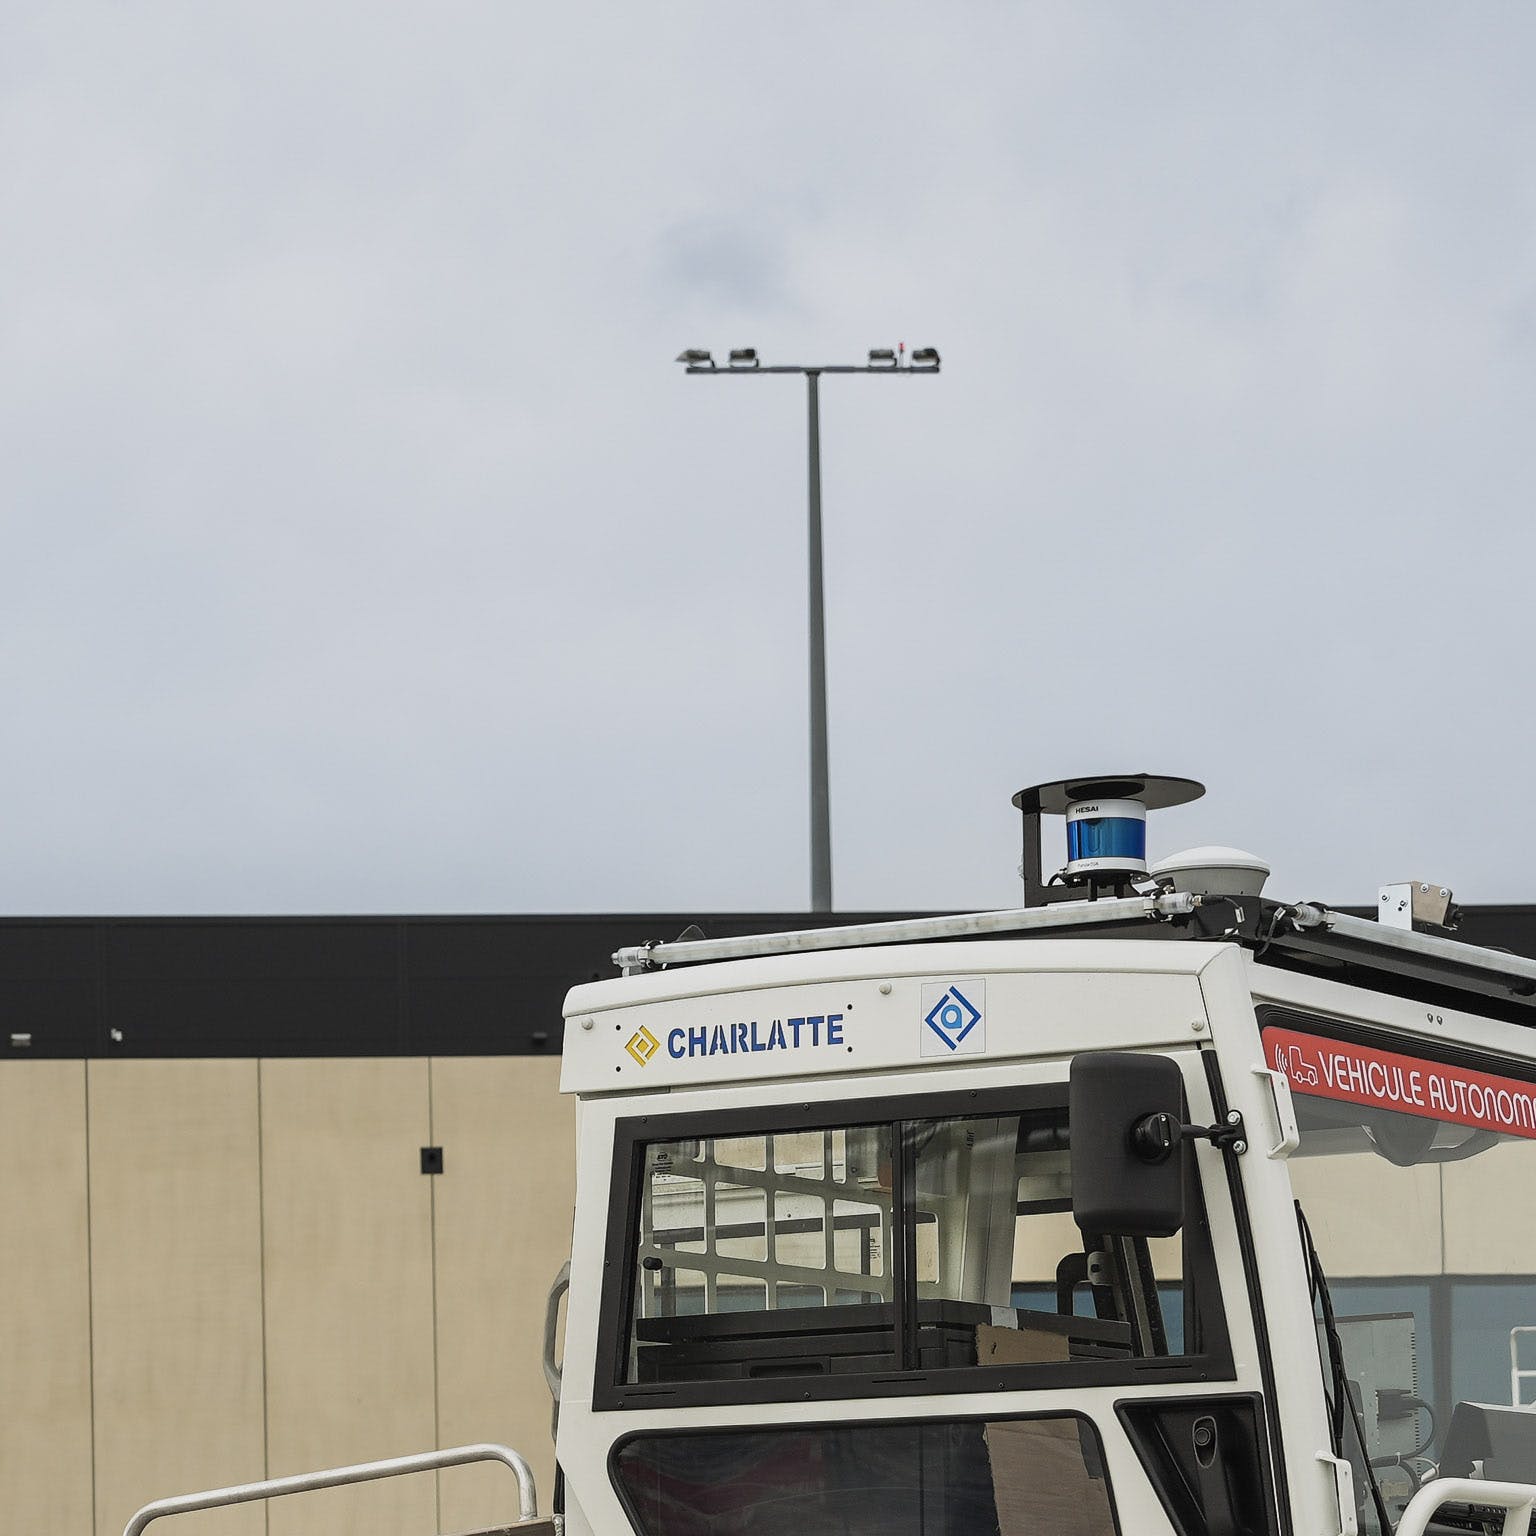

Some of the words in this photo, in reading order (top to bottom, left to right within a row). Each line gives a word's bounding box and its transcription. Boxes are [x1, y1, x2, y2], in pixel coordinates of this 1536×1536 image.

[1075, 806, 1099, 814] HESAI
[667, 1014, 844, 1059] CHARLATTE
[1318, 1051, 1424, 1107] VEHICULE
